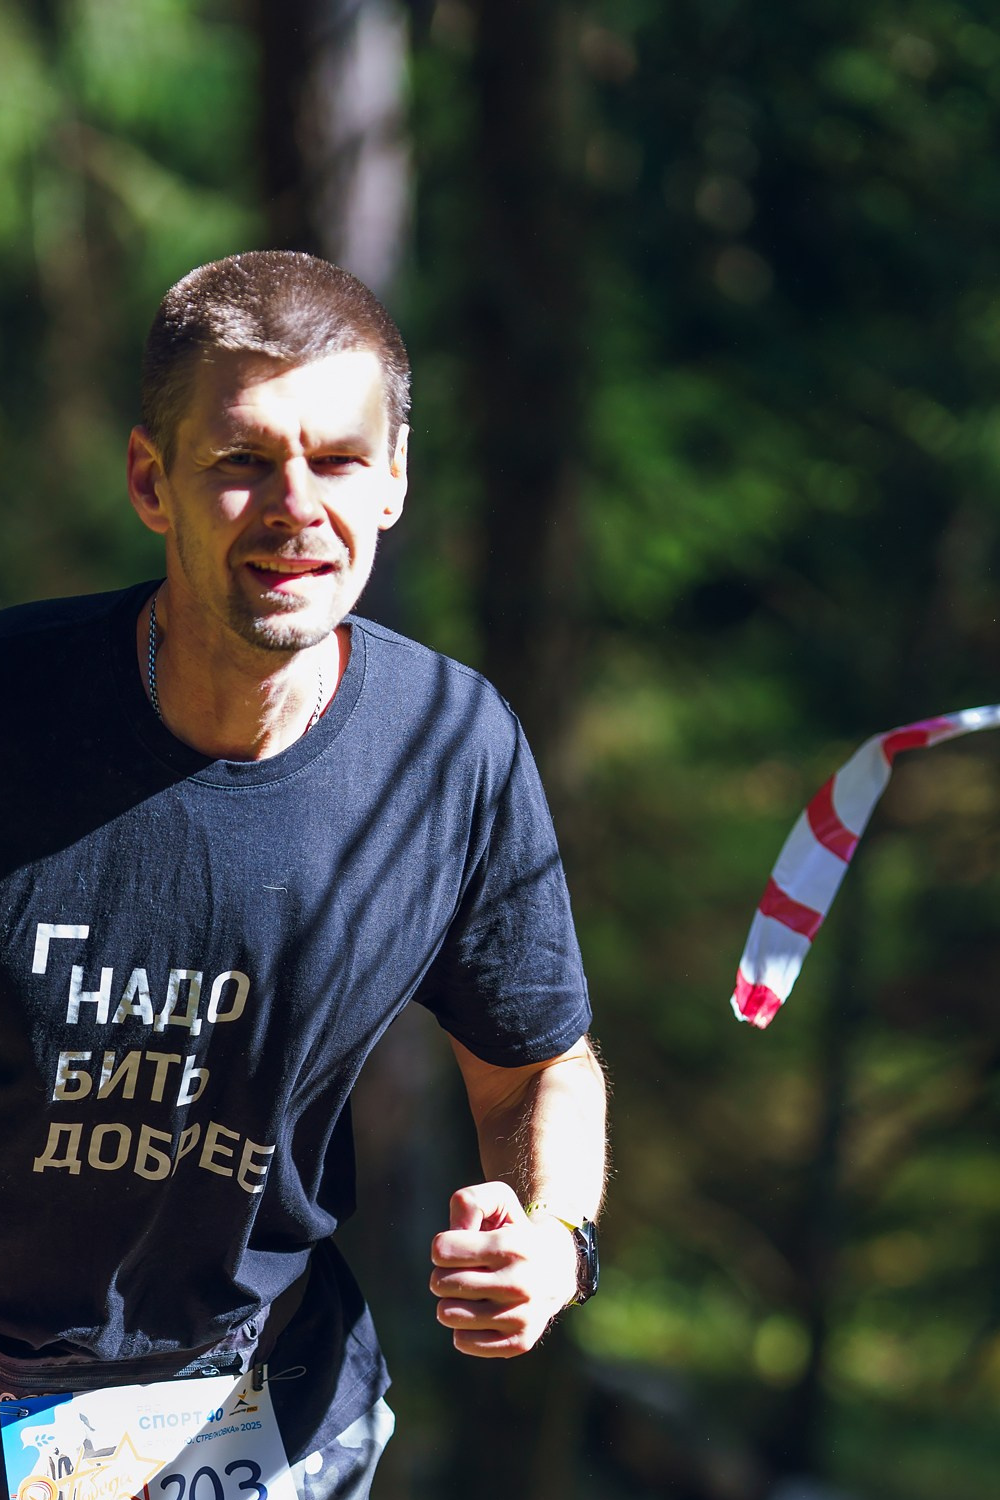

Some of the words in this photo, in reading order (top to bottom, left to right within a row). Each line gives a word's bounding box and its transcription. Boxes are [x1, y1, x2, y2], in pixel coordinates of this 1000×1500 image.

[66, 965, 251, 1036] НАДО
[52, 1050, 210, 1107] БИТЬ
[33, 1120, 275, 1194] ДОБРЕЕ
[138, 1411, 202, 1430] СПОРТ
[206, 1407, 224, 1423] 40
[240, 1420, 263, 1432] 2025
